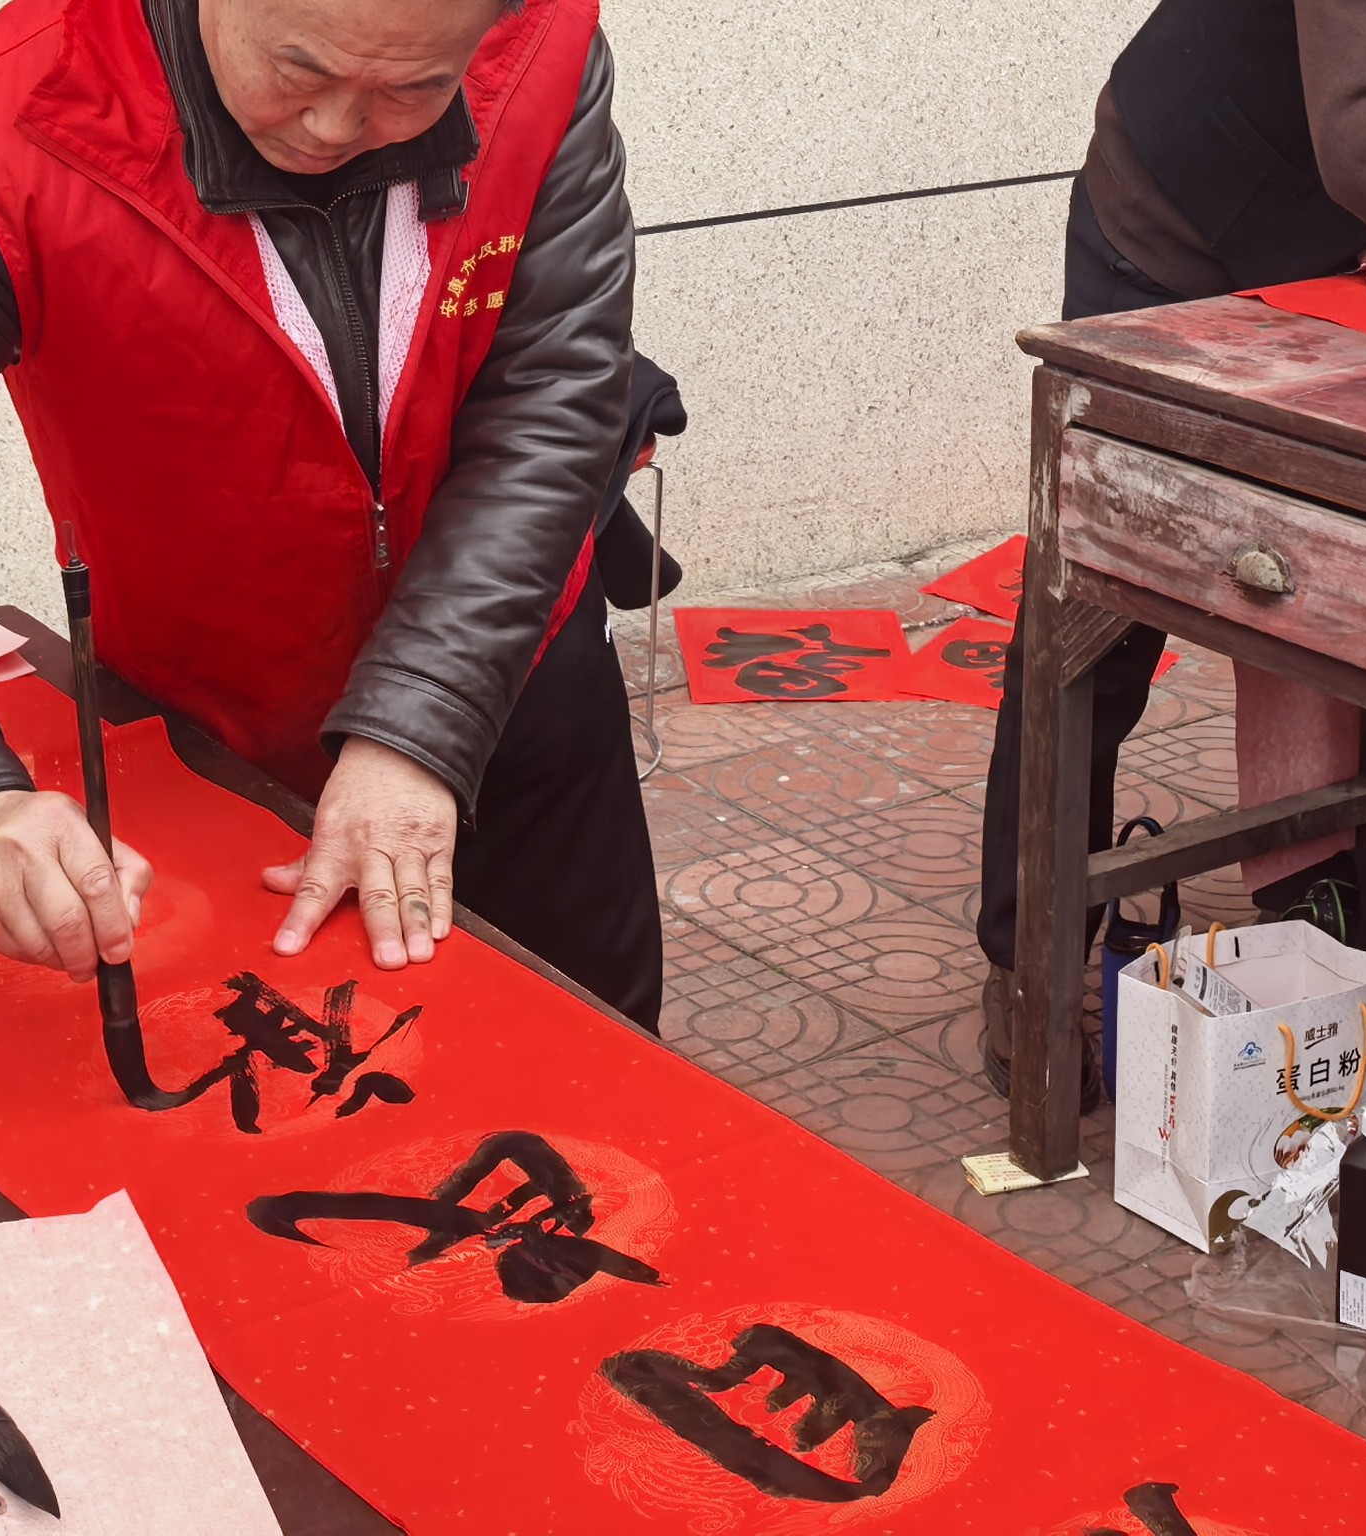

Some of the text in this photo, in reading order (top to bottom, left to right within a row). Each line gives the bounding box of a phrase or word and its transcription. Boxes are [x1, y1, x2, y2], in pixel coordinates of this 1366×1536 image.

[440, 234, 526, 318] 安康市反邪
[1276, 1047, 1361, 1095] 蛋白粉
